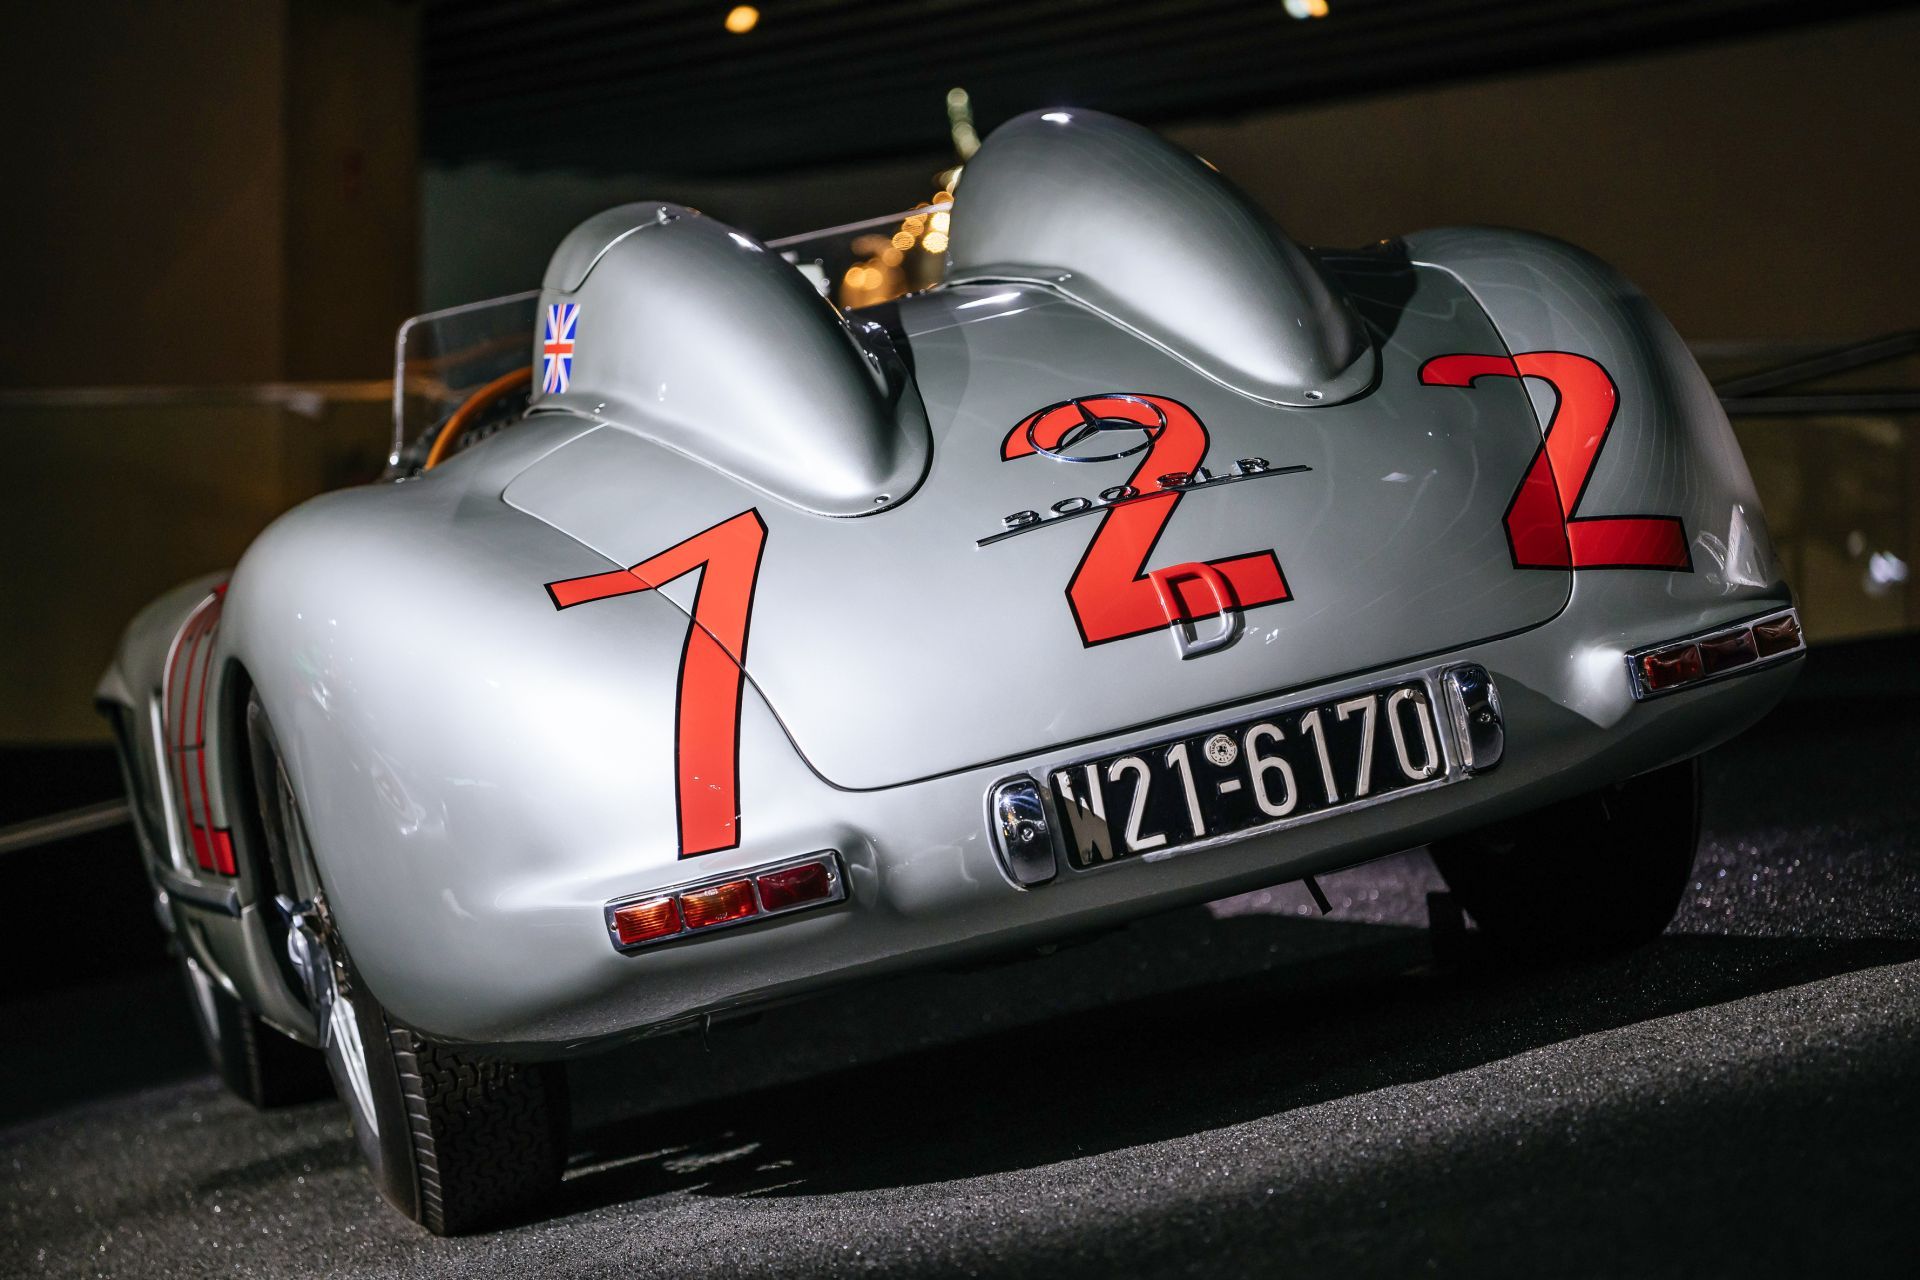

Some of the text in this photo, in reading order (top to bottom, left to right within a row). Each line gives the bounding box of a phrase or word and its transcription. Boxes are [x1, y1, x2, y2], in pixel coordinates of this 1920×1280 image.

[1001, 456, 1271, 529] 300 SLR
[1149, 561, 1239, 661] D
